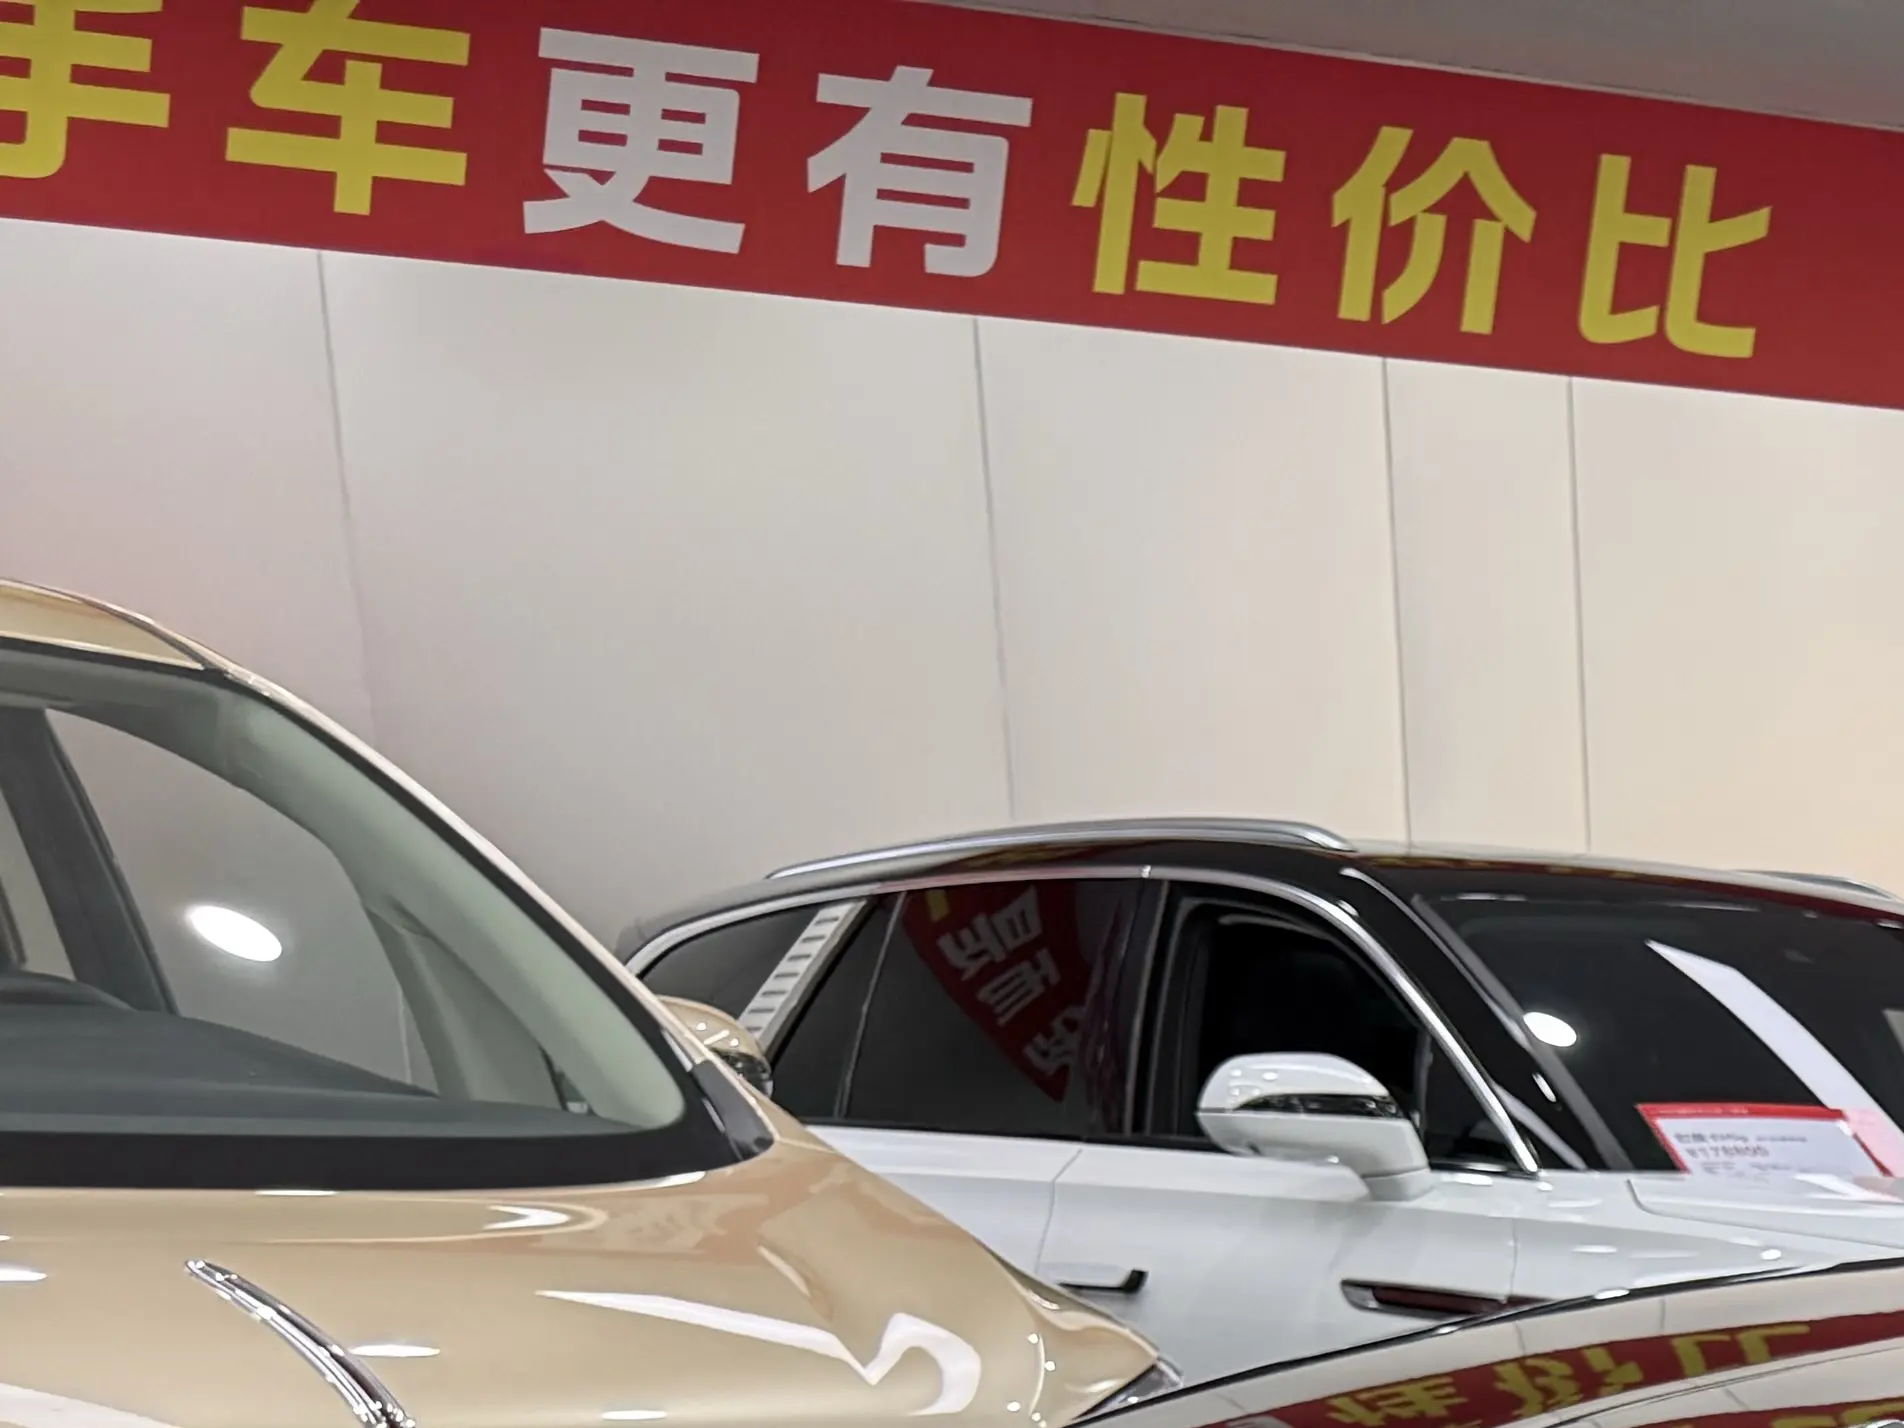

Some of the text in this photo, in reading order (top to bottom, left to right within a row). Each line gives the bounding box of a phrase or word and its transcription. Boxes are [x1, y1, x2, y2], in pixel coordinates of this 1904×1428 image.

[0, 0, 1774, 360] 手车更有性价比
